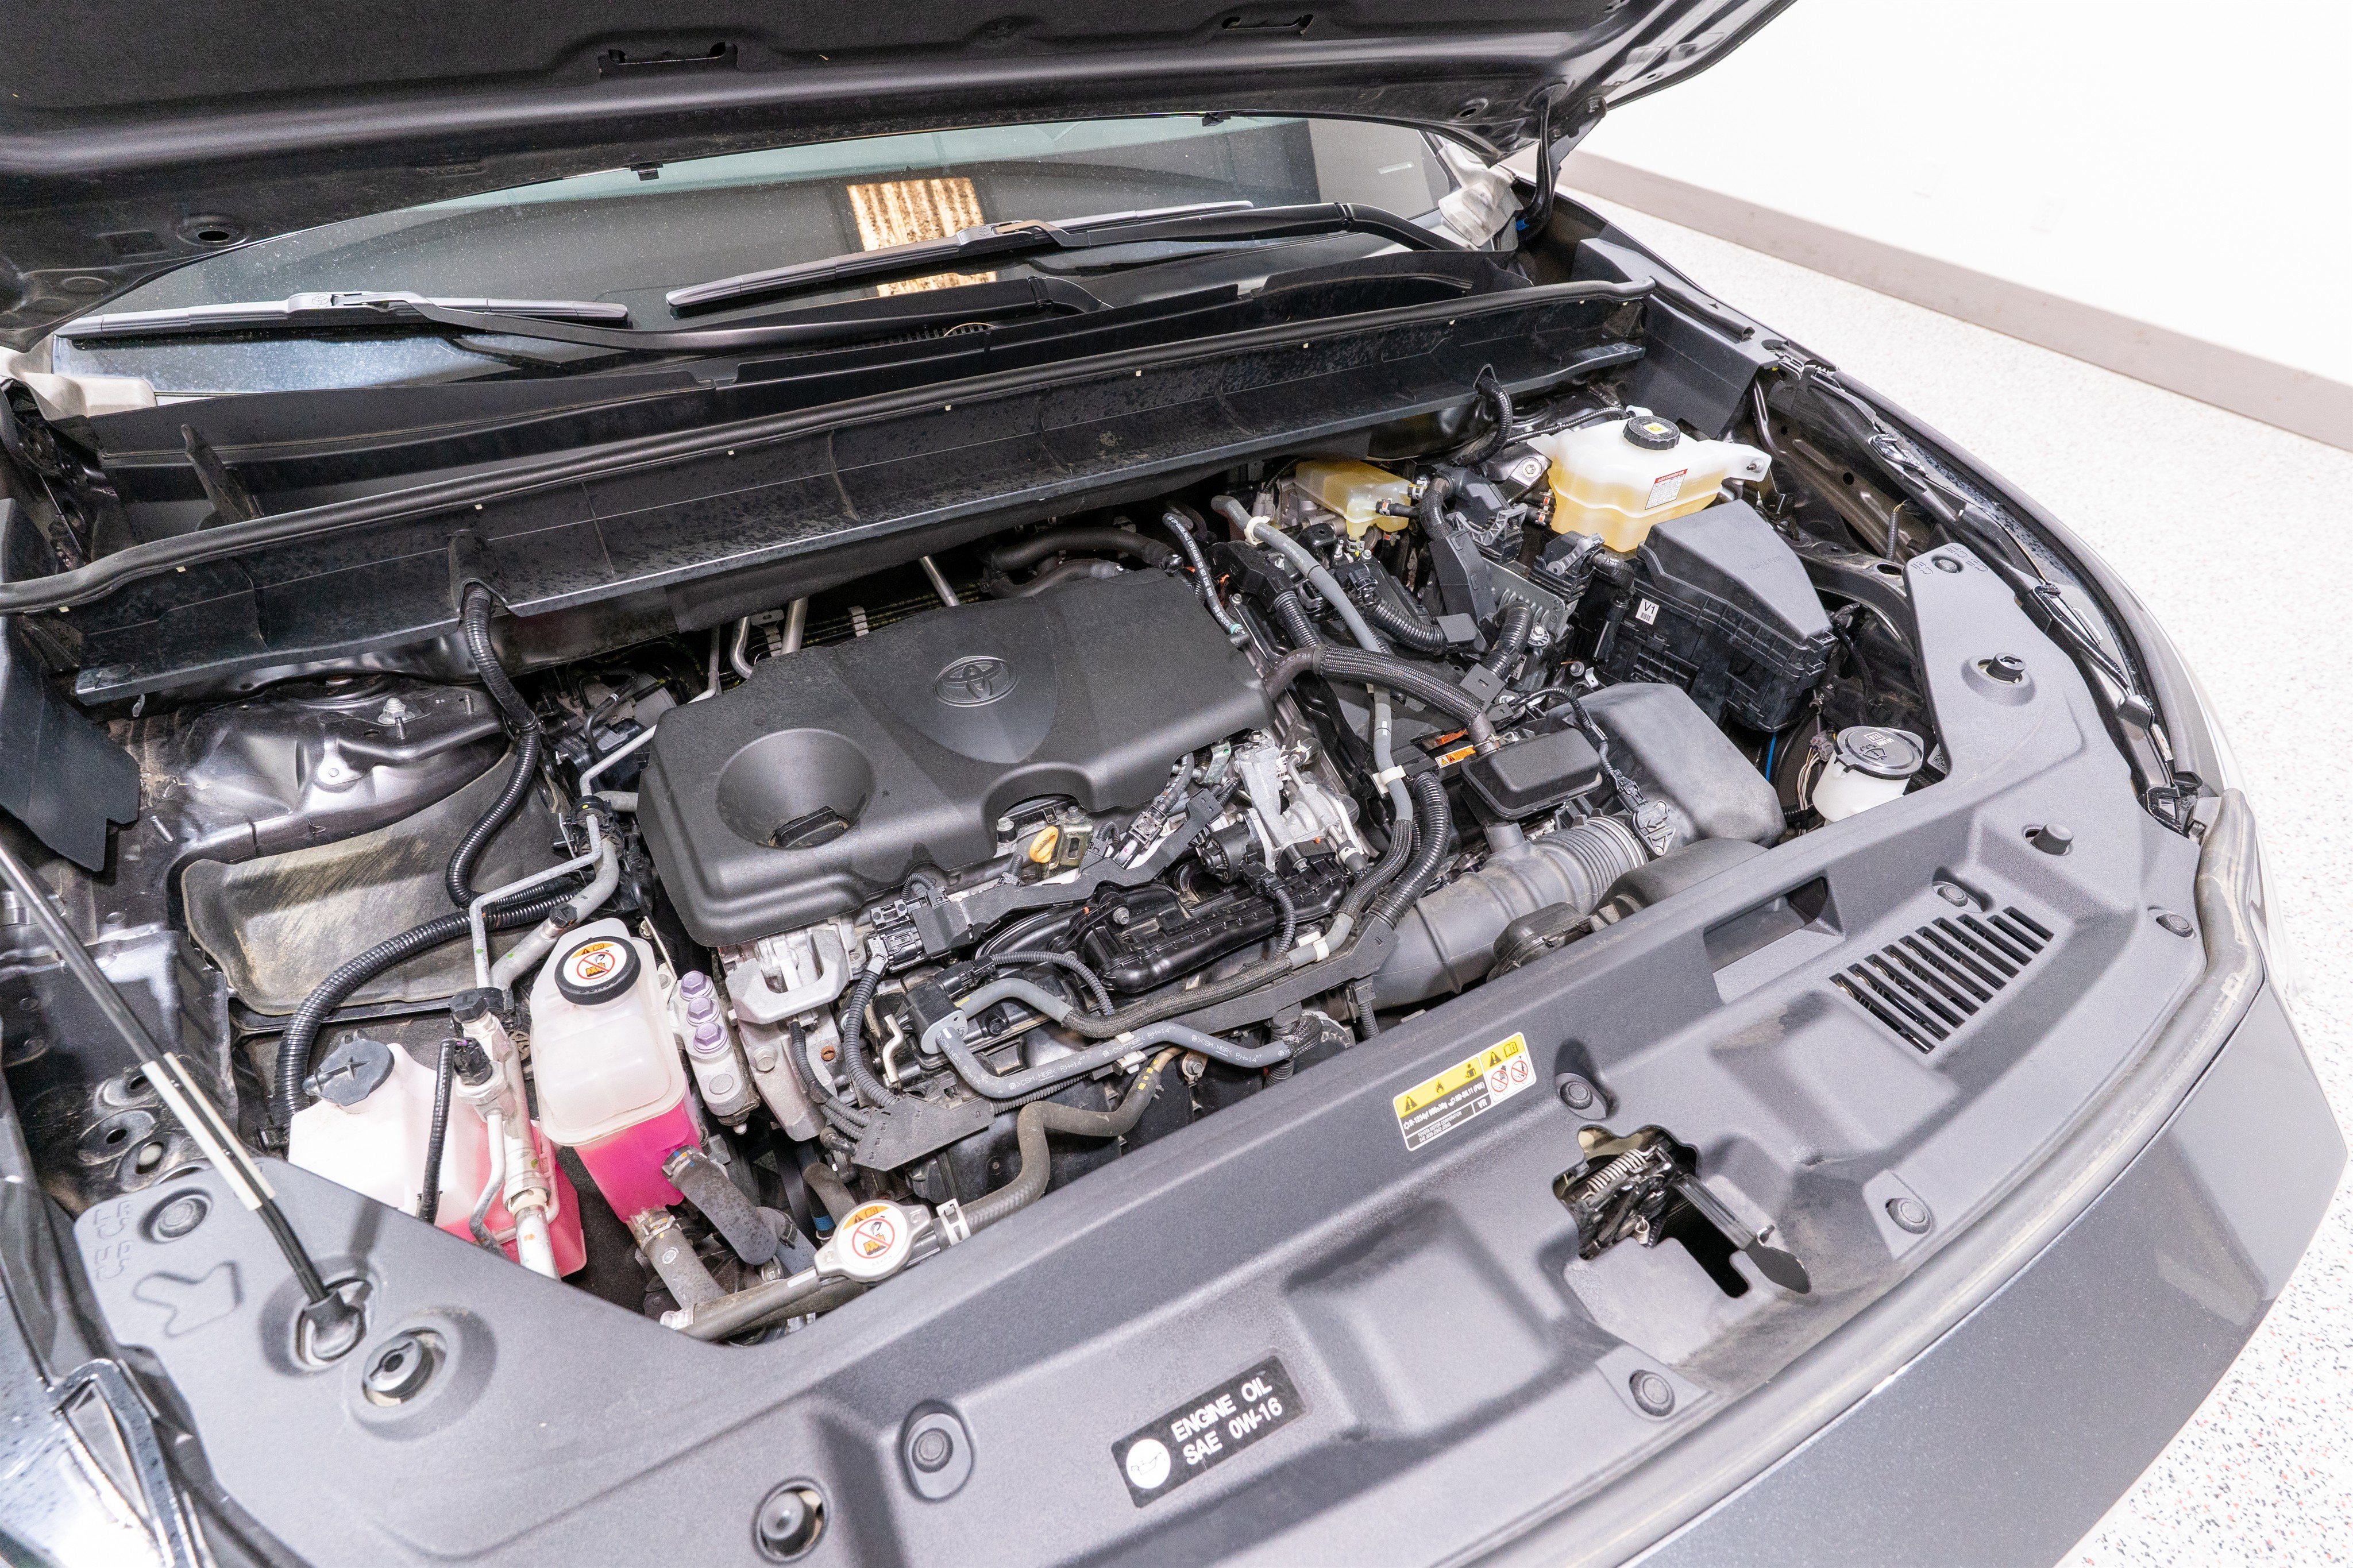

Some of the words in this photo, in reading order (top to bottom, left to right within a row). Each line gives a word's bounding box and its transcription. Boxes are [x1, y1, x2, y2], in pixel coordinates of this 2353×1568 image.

[1644, 601, 1656, 614] V1
[1477, 1098, 1487, 1109] VR
[1417, 1128, 1430, 1138] TOYOTA
[1429, 1122, 1441, 1131] MOTOR
[1440, 1111, 1462, 1125] CORPORATION
[1171, 1393, 1237, 1443] ENGINE
[1241, 1377, 1273, 1402] OIL
[1183, 1431, 1223, 1465] SAE
[1228, 1397, 1283, 1439] 0W-16
